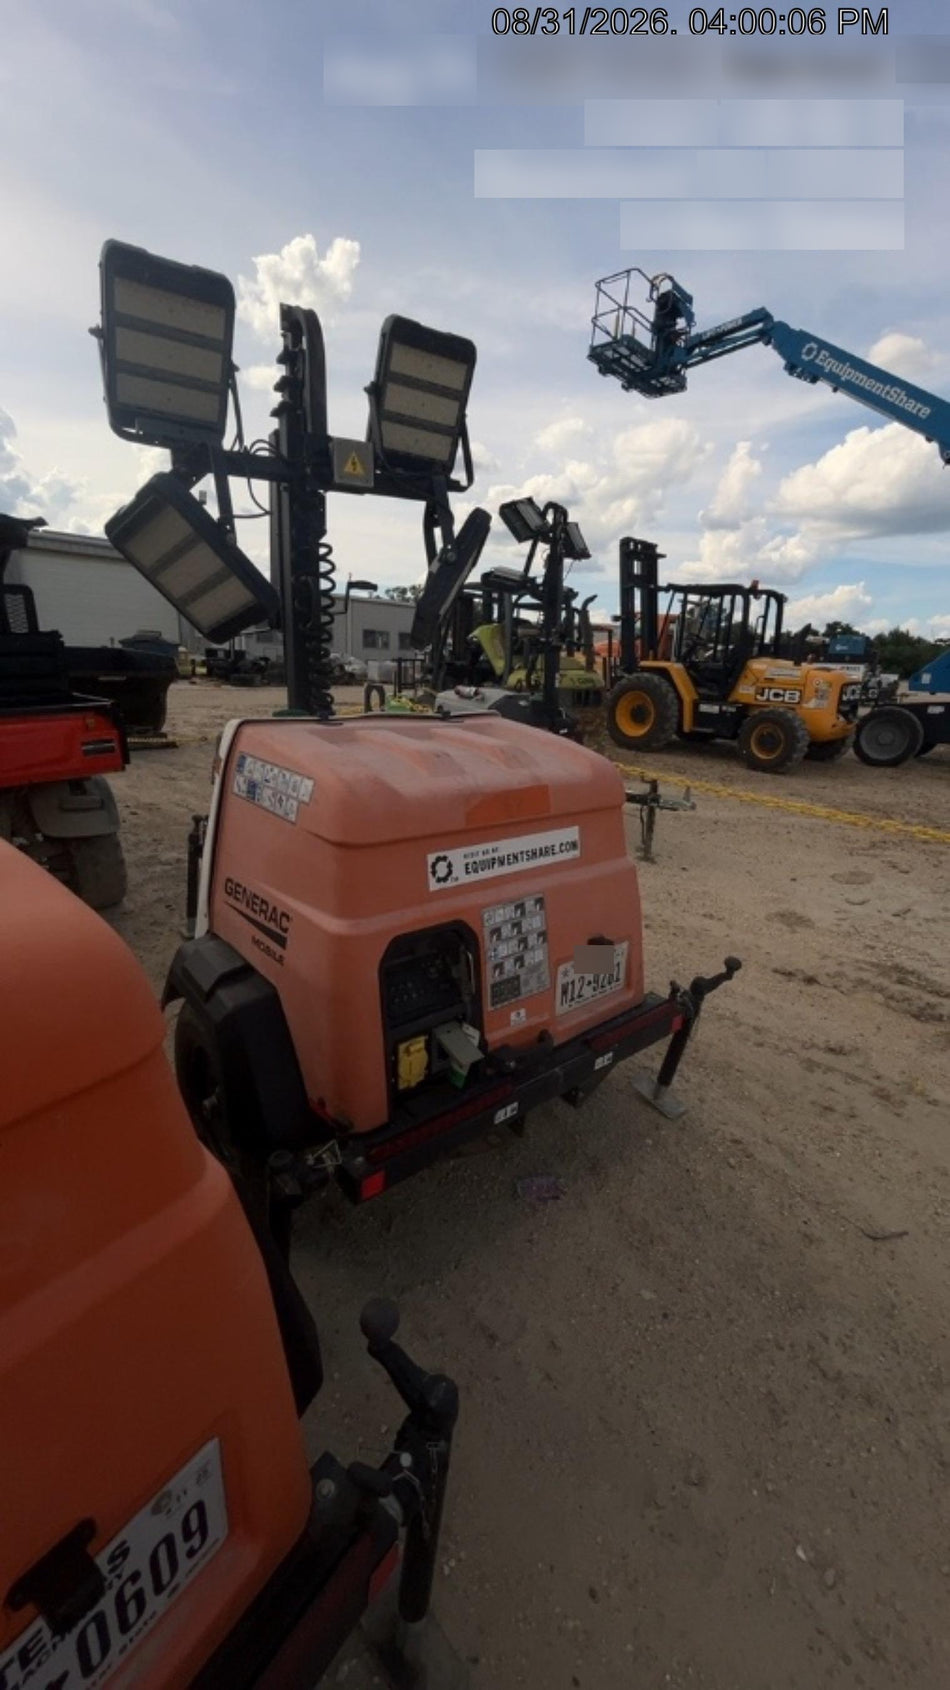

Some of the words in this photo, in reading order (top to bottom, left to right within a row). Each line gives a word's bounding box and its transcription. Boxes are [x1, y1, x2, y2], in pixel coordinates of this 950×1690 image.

[815, 349, 931, 420] EquipmentShare
[756, 688, 801, 703] JCB
[464, 840, 579, 875] EQUIPMENTSHARE.COM
[224, 877, 290, 933] GENERAC
[251, 935, 285, 966] MOBILE
